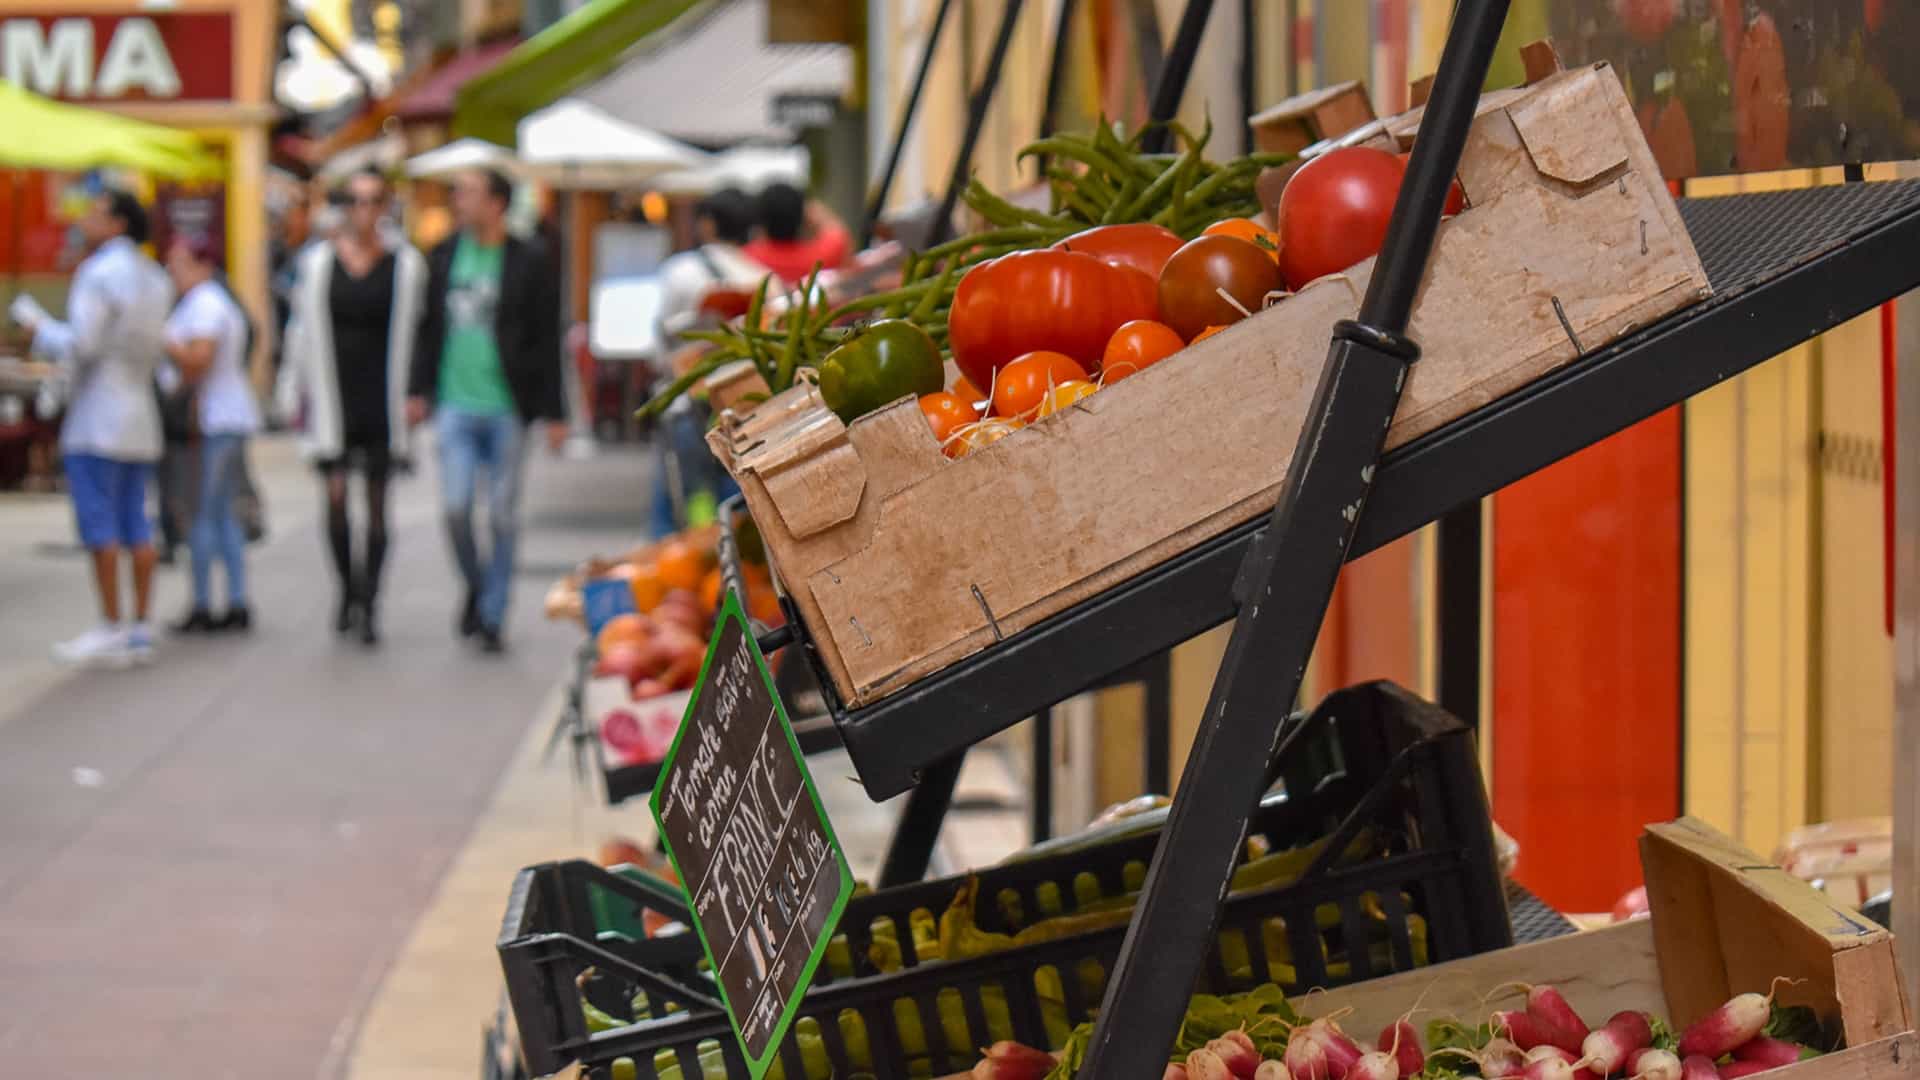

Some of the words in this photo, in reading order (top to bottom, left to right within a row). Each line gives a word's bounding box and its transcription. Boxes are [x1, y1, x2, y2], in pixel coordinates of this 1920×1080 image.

[3, 17, 182, 97] MA
[671, 719, 721, 818] Tomate
[713, 735, 792, 937] FRANCE
